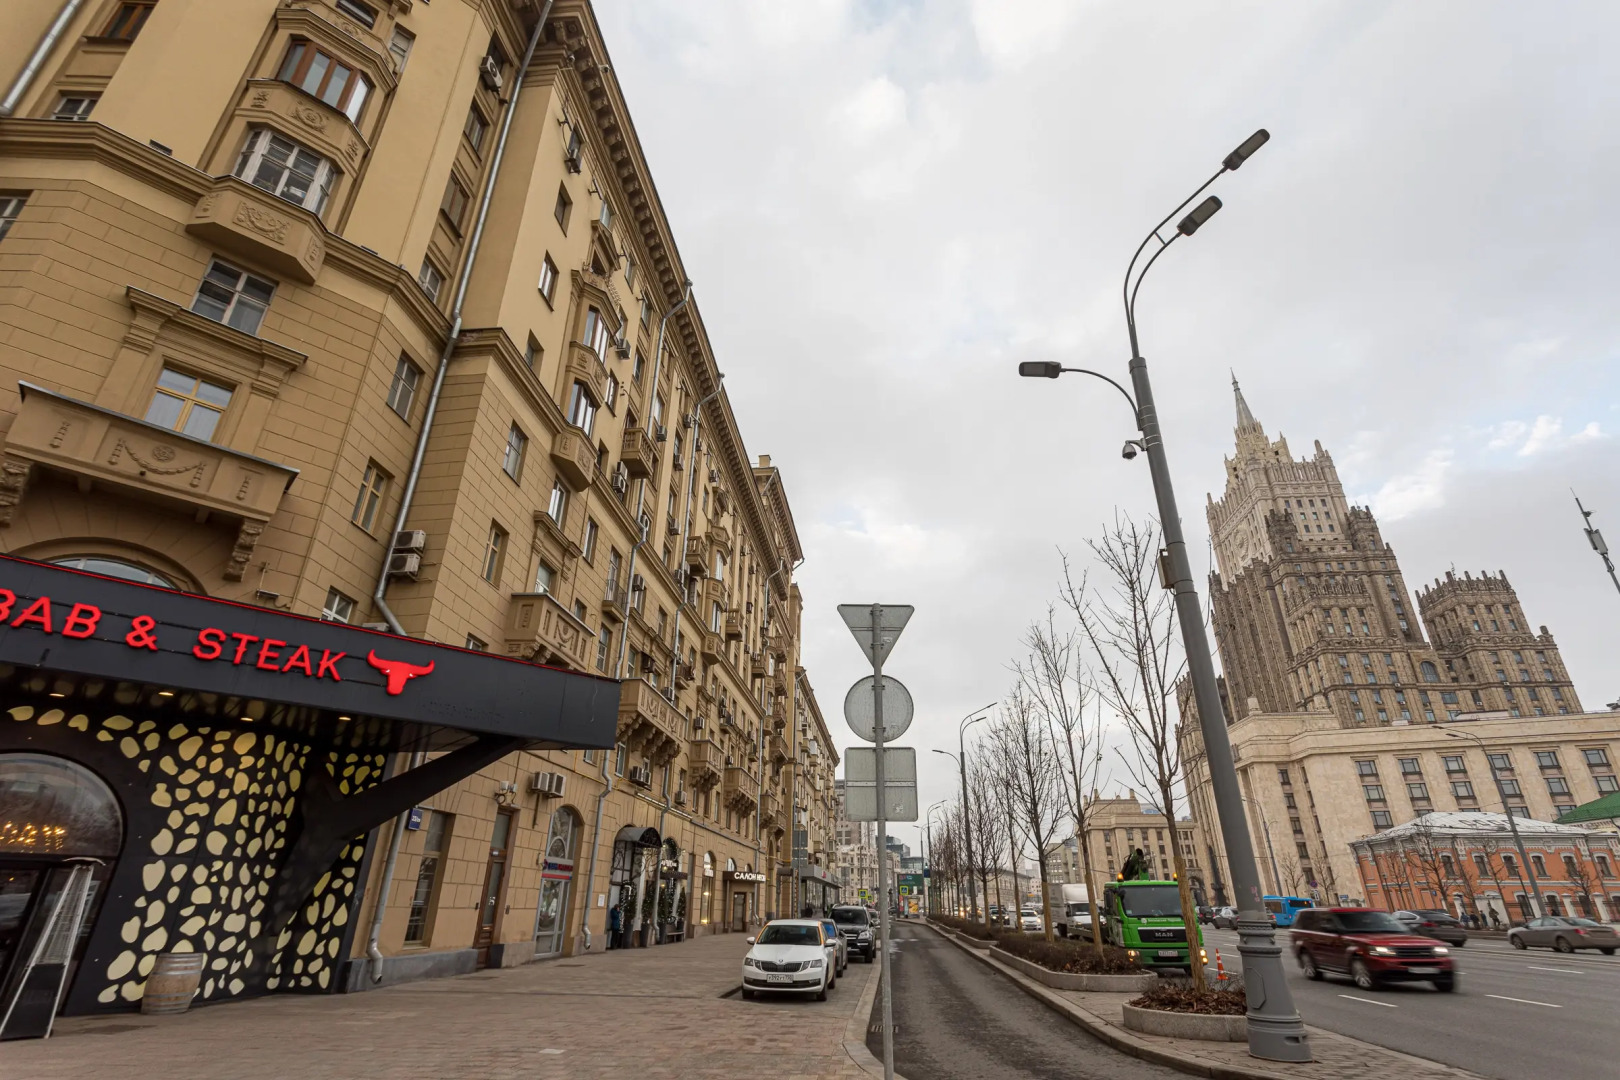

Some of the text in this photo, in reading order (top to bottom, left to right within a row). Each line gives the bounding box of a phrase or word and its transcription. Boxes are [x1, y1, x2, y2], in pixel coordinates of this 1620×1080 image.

[125, 615, 158, 651] &
[192, 627, 347, 681] STEAK
[734, 871, 757, 881] САЛОН
